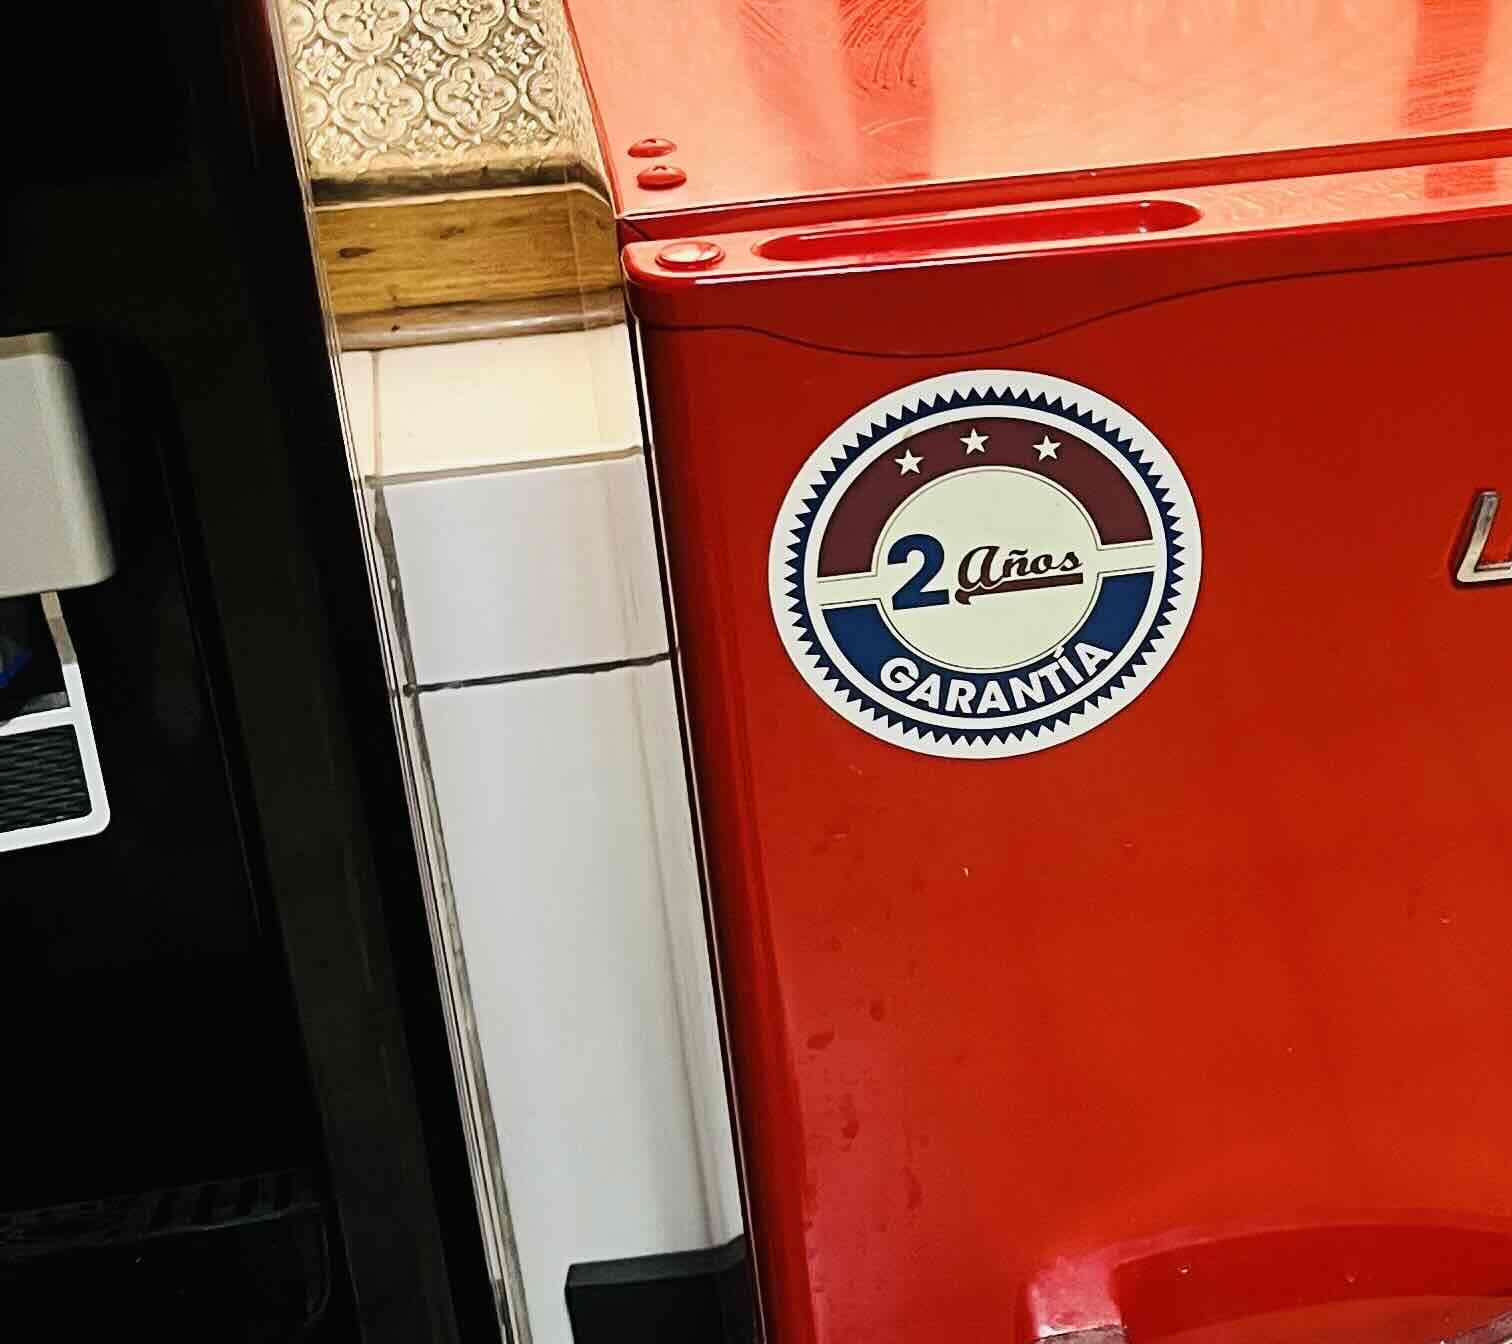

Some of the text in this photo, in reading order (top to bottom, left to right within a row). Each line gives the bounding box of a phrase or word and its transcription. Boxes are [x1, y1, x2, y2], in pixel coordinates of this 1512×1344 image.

[887, 533, 1084, 611] 2 Años
[880, 642, 1114, 715] GARANTÍA
